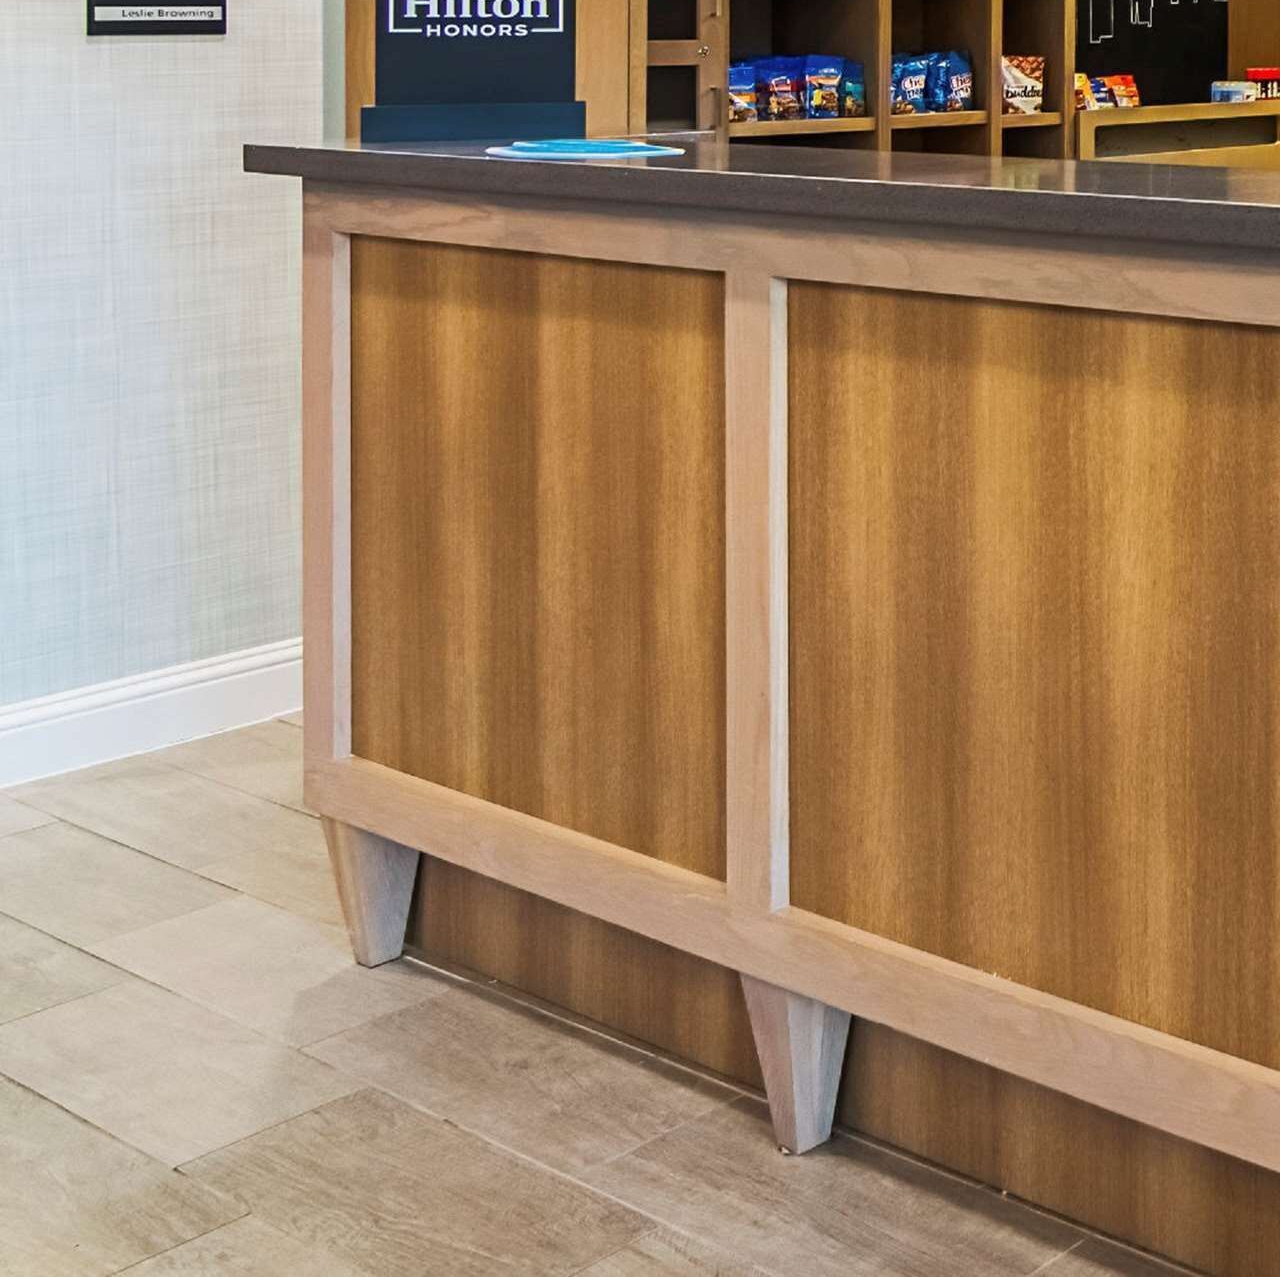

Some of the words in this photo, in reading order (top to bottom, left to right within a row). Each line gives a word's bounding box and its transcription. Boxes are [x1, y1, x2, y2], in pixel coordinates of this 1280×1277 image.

[121, 9, 154, 18] Leslie
[157, 9, 214, 18] Browning
[426, 24, 529, 37] HONORS
